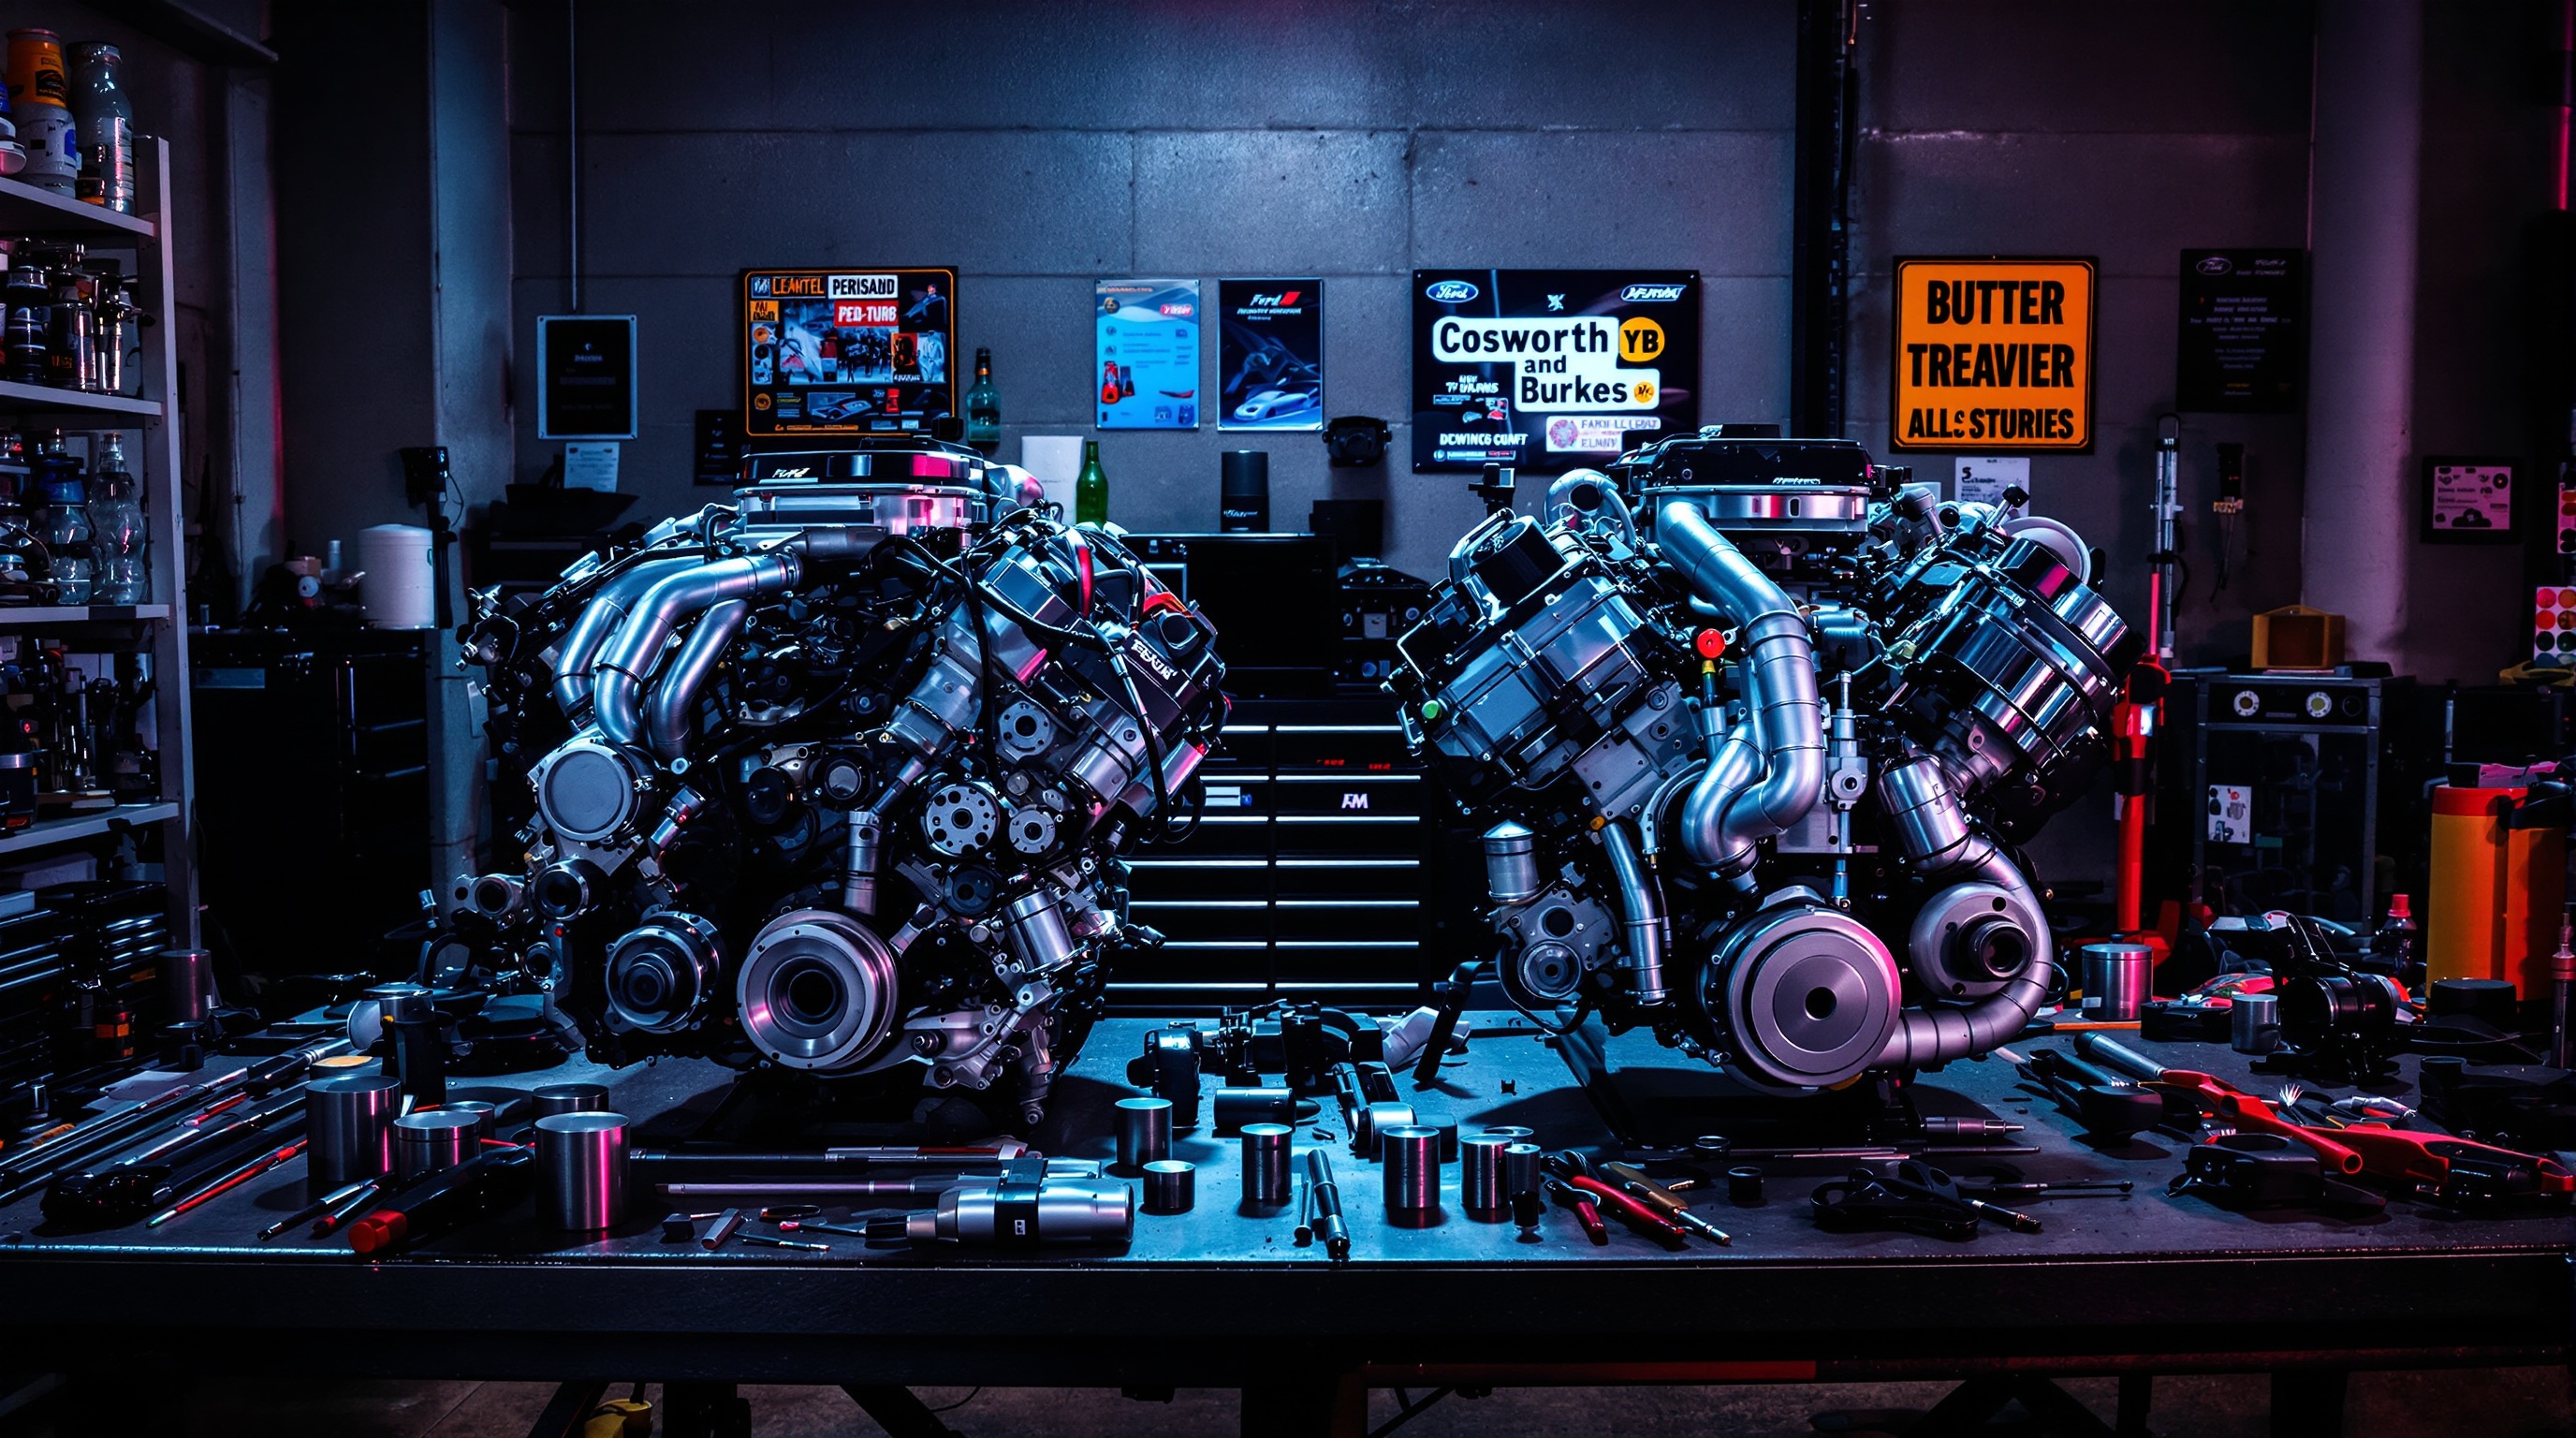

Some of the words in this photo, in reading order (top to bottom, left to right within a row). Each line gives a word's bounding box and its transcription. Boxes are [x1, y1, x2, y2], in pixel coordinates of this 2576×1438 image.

[1926, 280, 2065, 325] BUTTER
[1440, 321, 1609, 354] Cosworth
[1623, 329, 1660, 354] YB
[1524, 355, 1567, 374] and
[1908, 343, 2075, 388] TREAVIER
[1521, 375, 1628, 404] Burkes
[1969, 407, 2074, 439] STURIES
